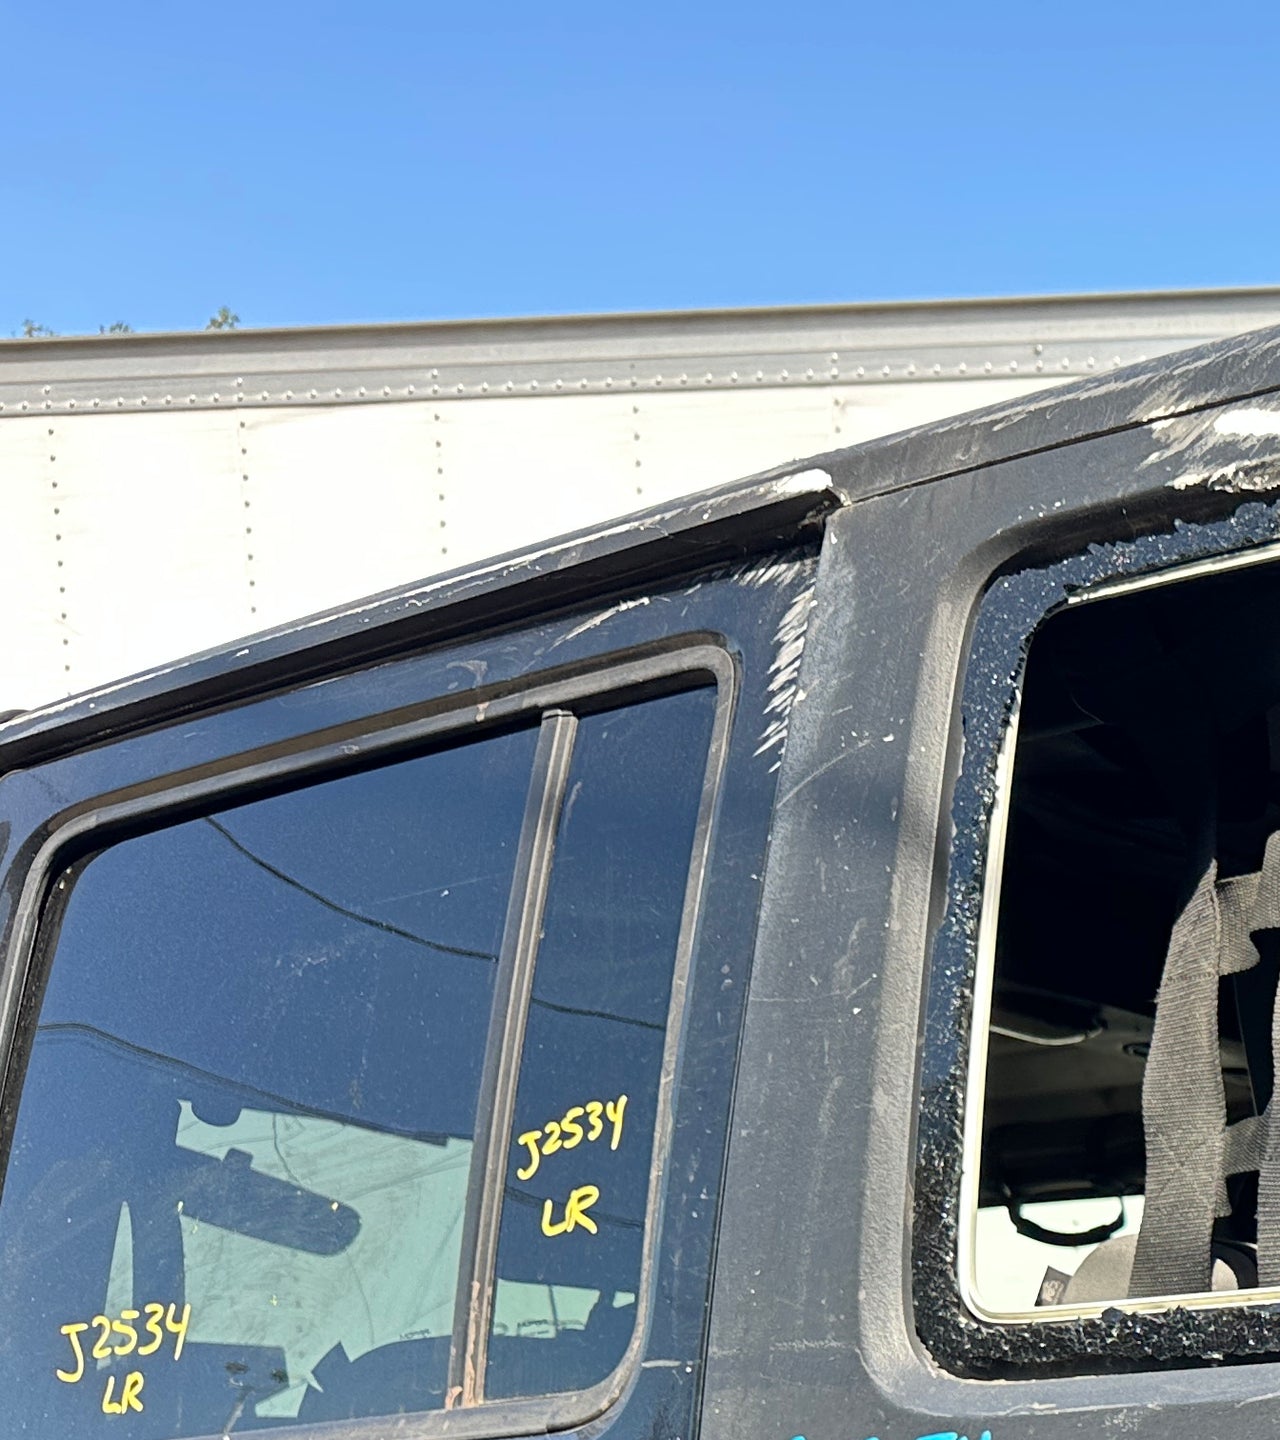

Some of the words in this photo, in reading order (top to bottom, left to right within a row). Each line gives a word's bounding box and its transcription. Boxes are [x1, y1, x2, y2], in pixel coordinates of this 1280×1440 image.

[517, 1095, 628, 1180] J2534
[541, 1185, 600, 1237] LR
[56, 1303, 192, 1383] J2534
[102, 1371, 144, 1414] LR
